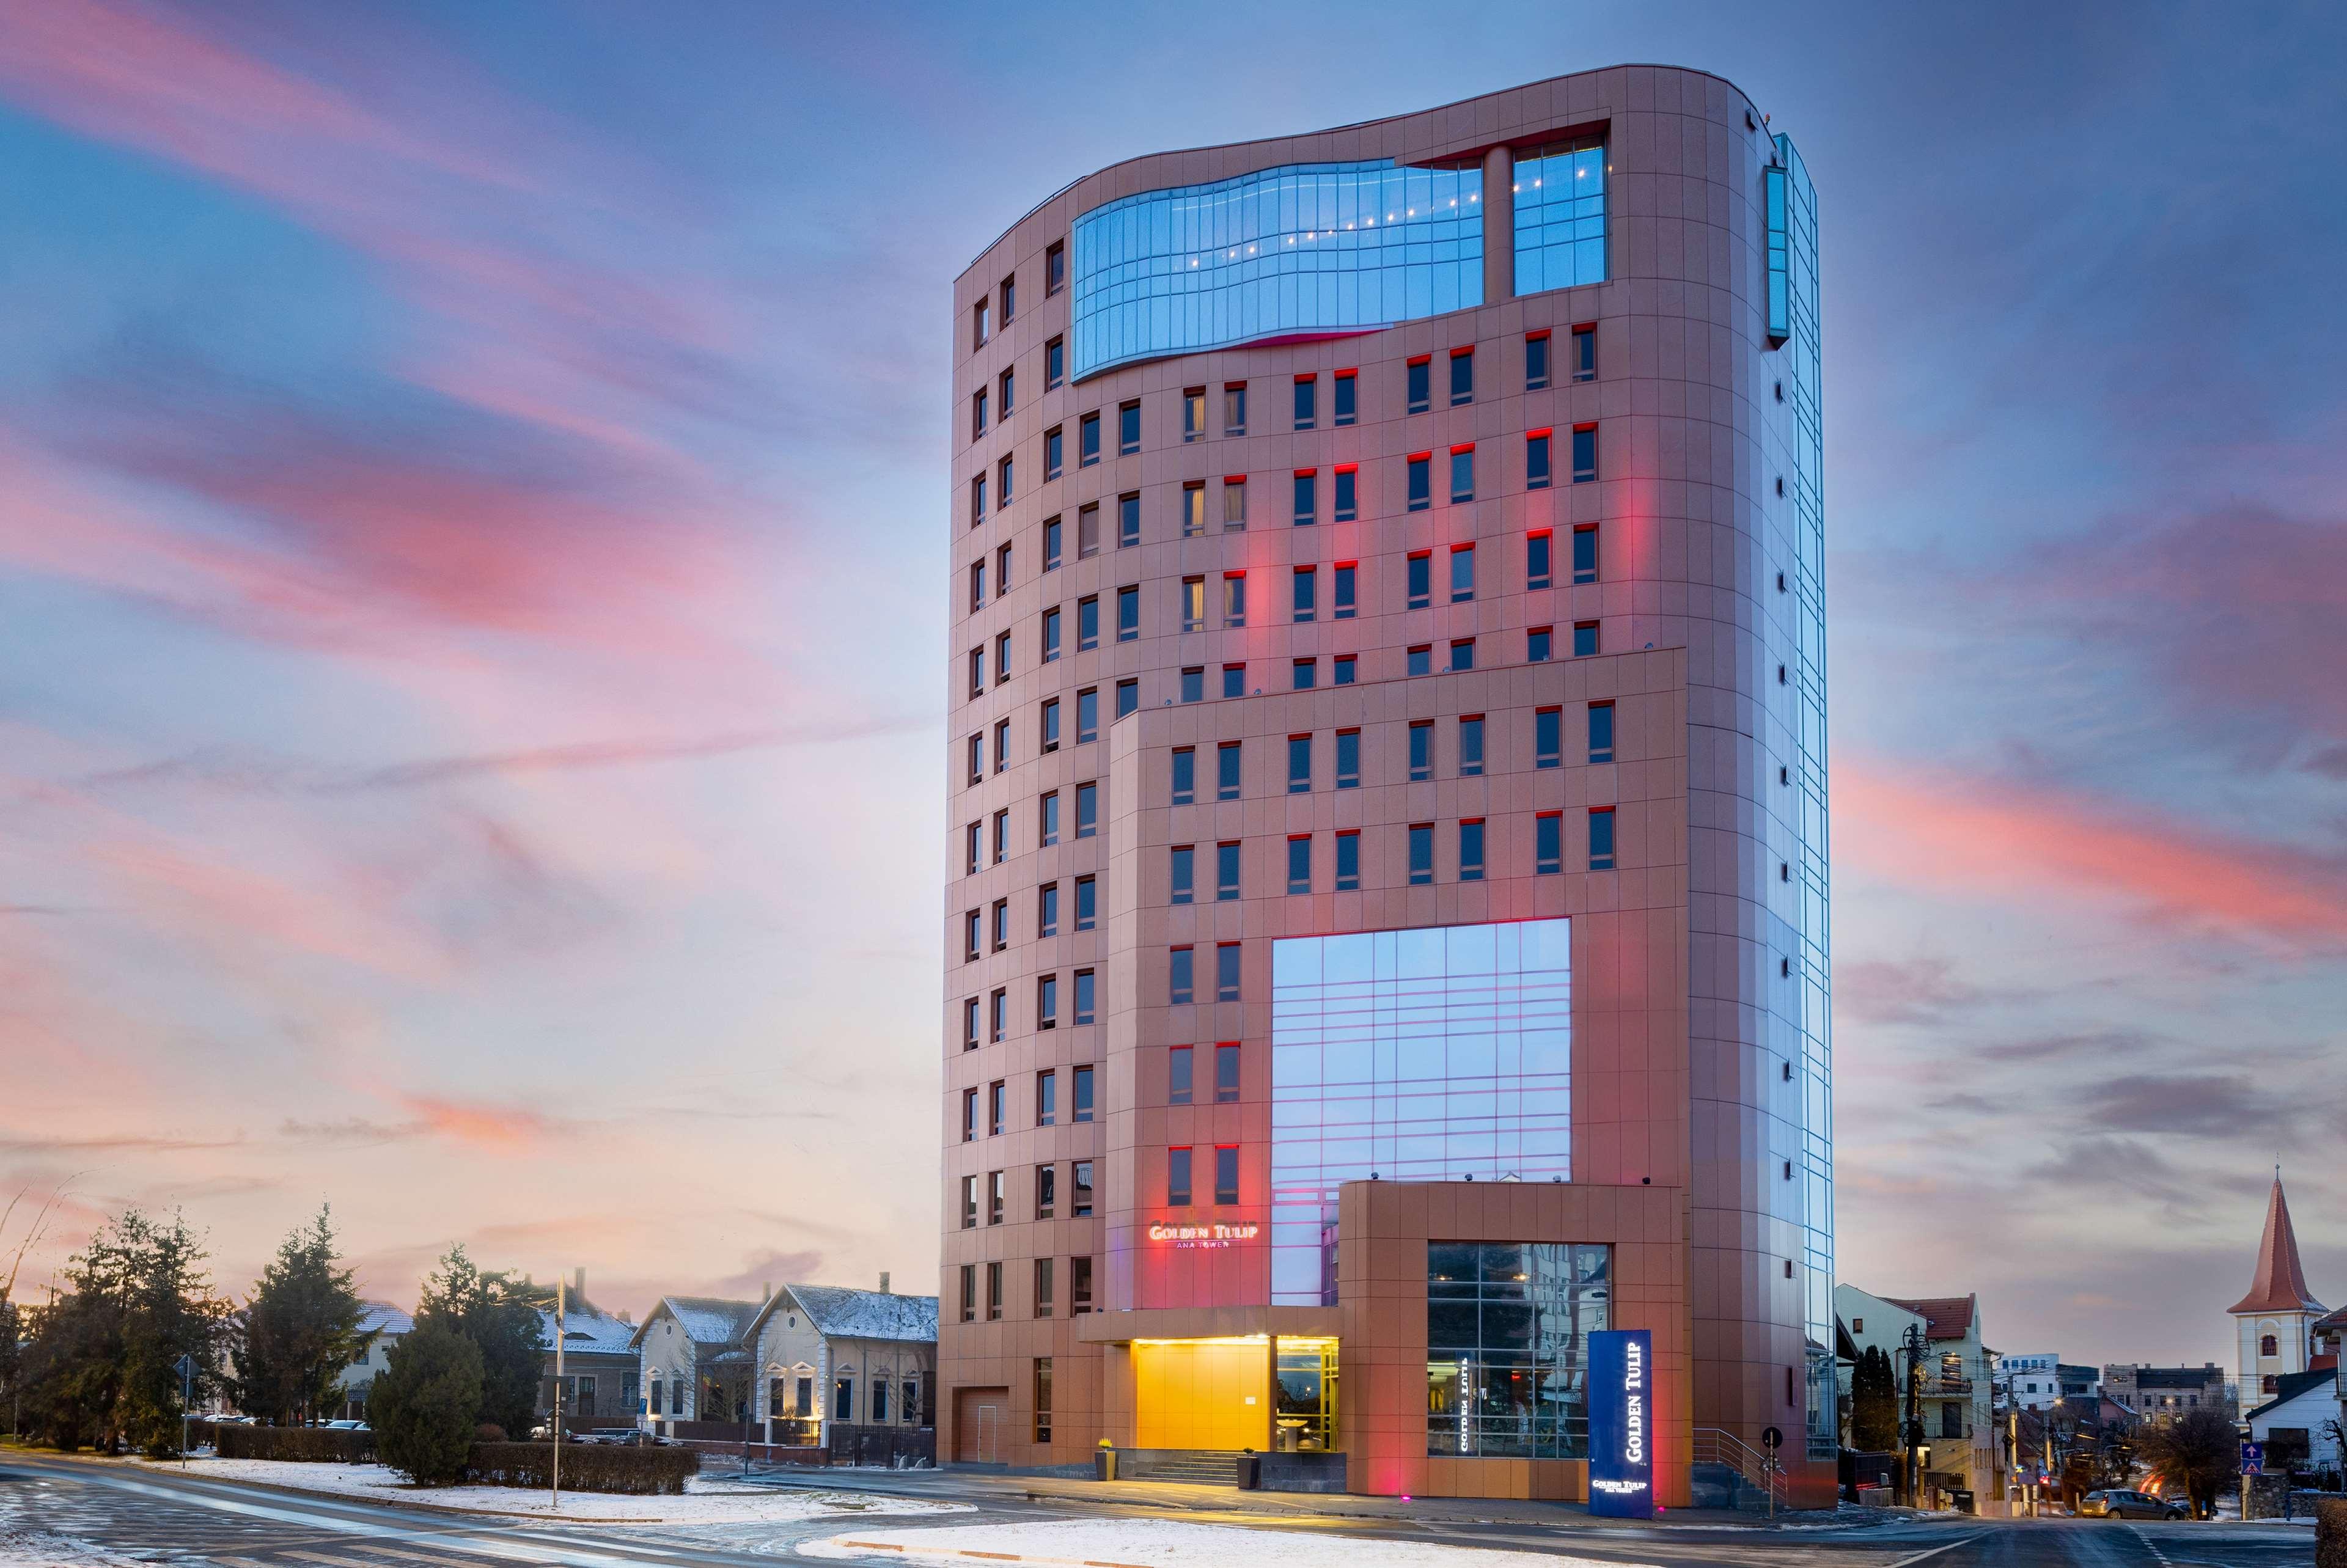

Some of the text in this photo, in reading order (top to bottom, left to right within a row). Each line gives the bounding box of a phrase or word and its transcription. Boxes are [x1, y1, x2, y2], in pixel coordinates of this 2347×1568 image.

[1149, 1225, 1258, 1240] GOLDEN TULIP
[1625, 1342, 1642, 1462] GOLDEN TULIP
